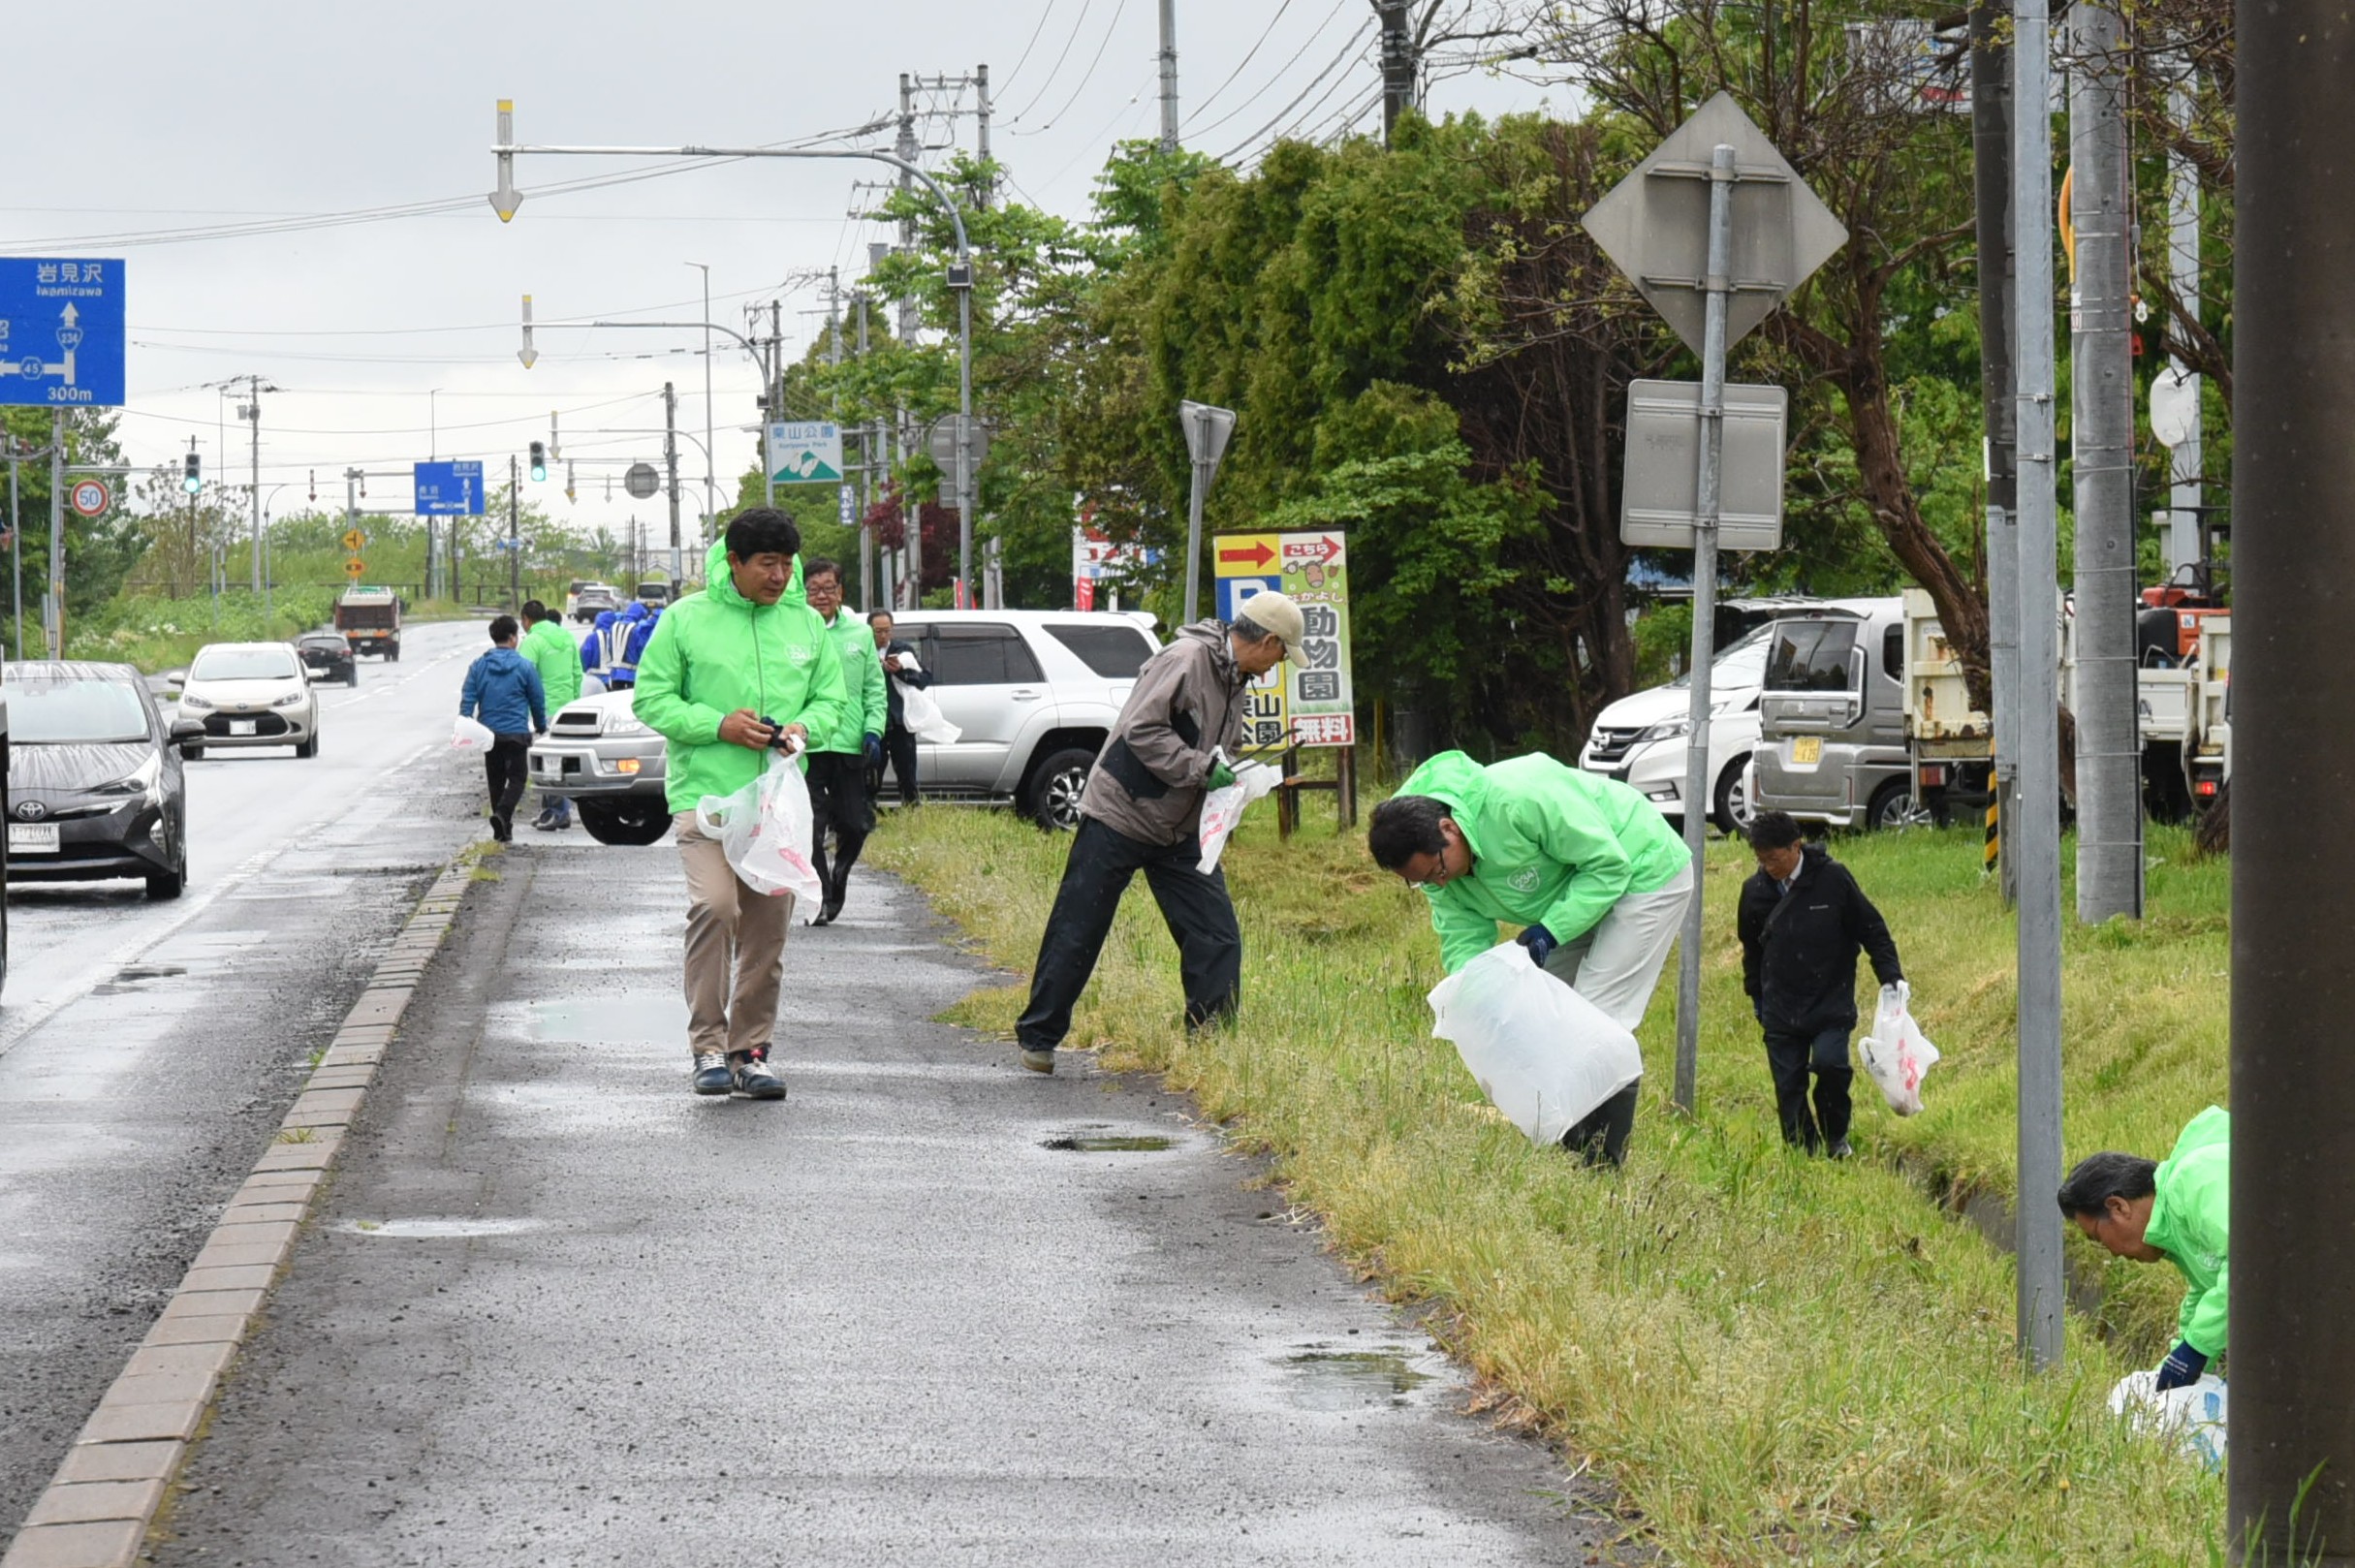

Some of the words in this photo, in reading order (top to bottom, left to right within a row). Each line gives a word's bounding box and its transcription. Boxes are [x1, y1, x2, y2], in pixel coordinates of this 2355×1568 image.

[36, 262, 103, 283] 岩見沢
[36, 285, 103, 297] Iwamizawa
[23, 362, 39, 374] 45
[47, 389, 92, 402] 300m
[78, 489, 100, 506] 50
[1289, 543, 1330, 556] こちら
[1300, 605, 1340, 702] 動物園
[1293, 715, 1349, 743] 無料
